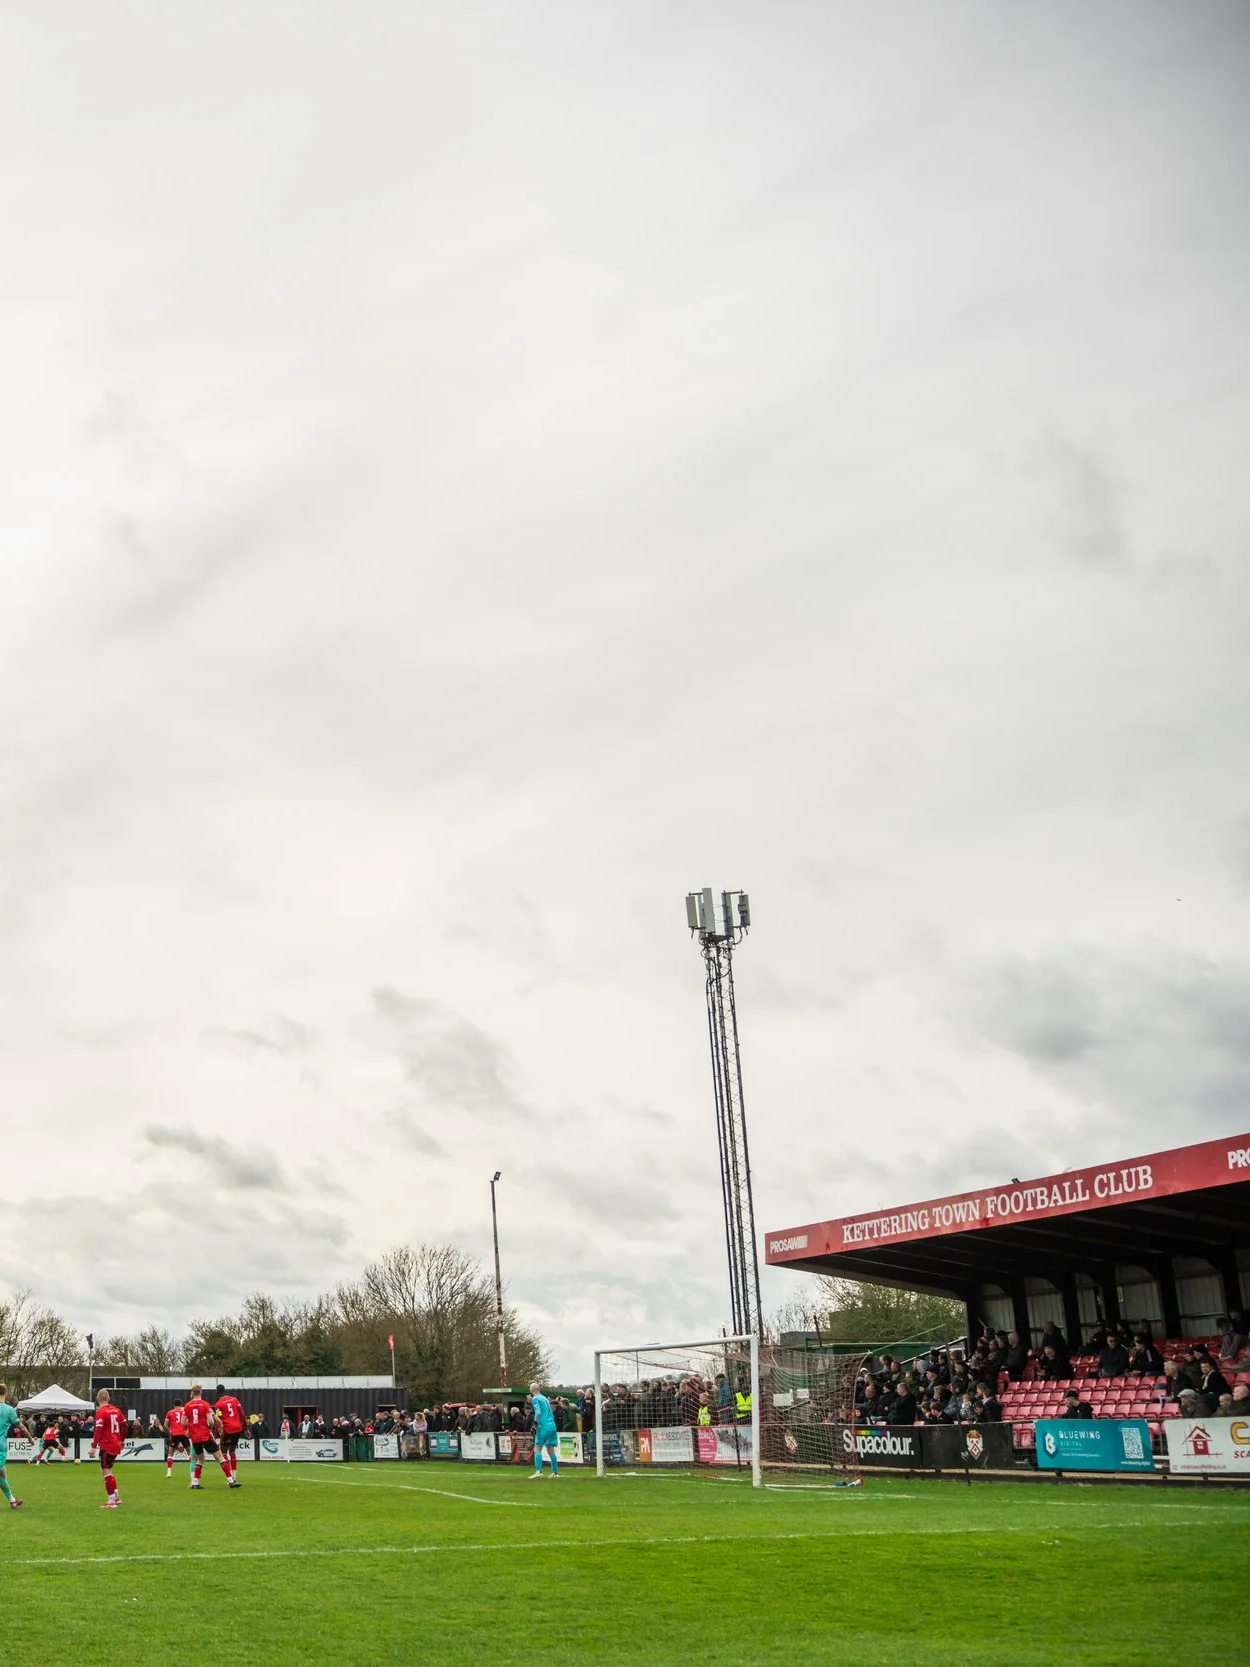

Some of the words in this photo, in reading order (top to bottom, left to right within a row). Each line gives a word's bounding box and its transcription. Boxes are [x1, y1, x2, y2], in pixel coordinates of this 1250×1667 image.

[842, 1210, 929, 1243] KETTERING
[932, 1200, 981, 1228] TOWN
[986, 1179, 1090, 1218] FOOTBALL
[1093, 1165, 1154, 1198] CLUB
[226, 1403, 235, 1417] 5
[175, 1412, 181, 1424] 3
[1058, 1430, 1101, 1440] BLUEWING
[8, 1441, 32, 1451] FUSE
